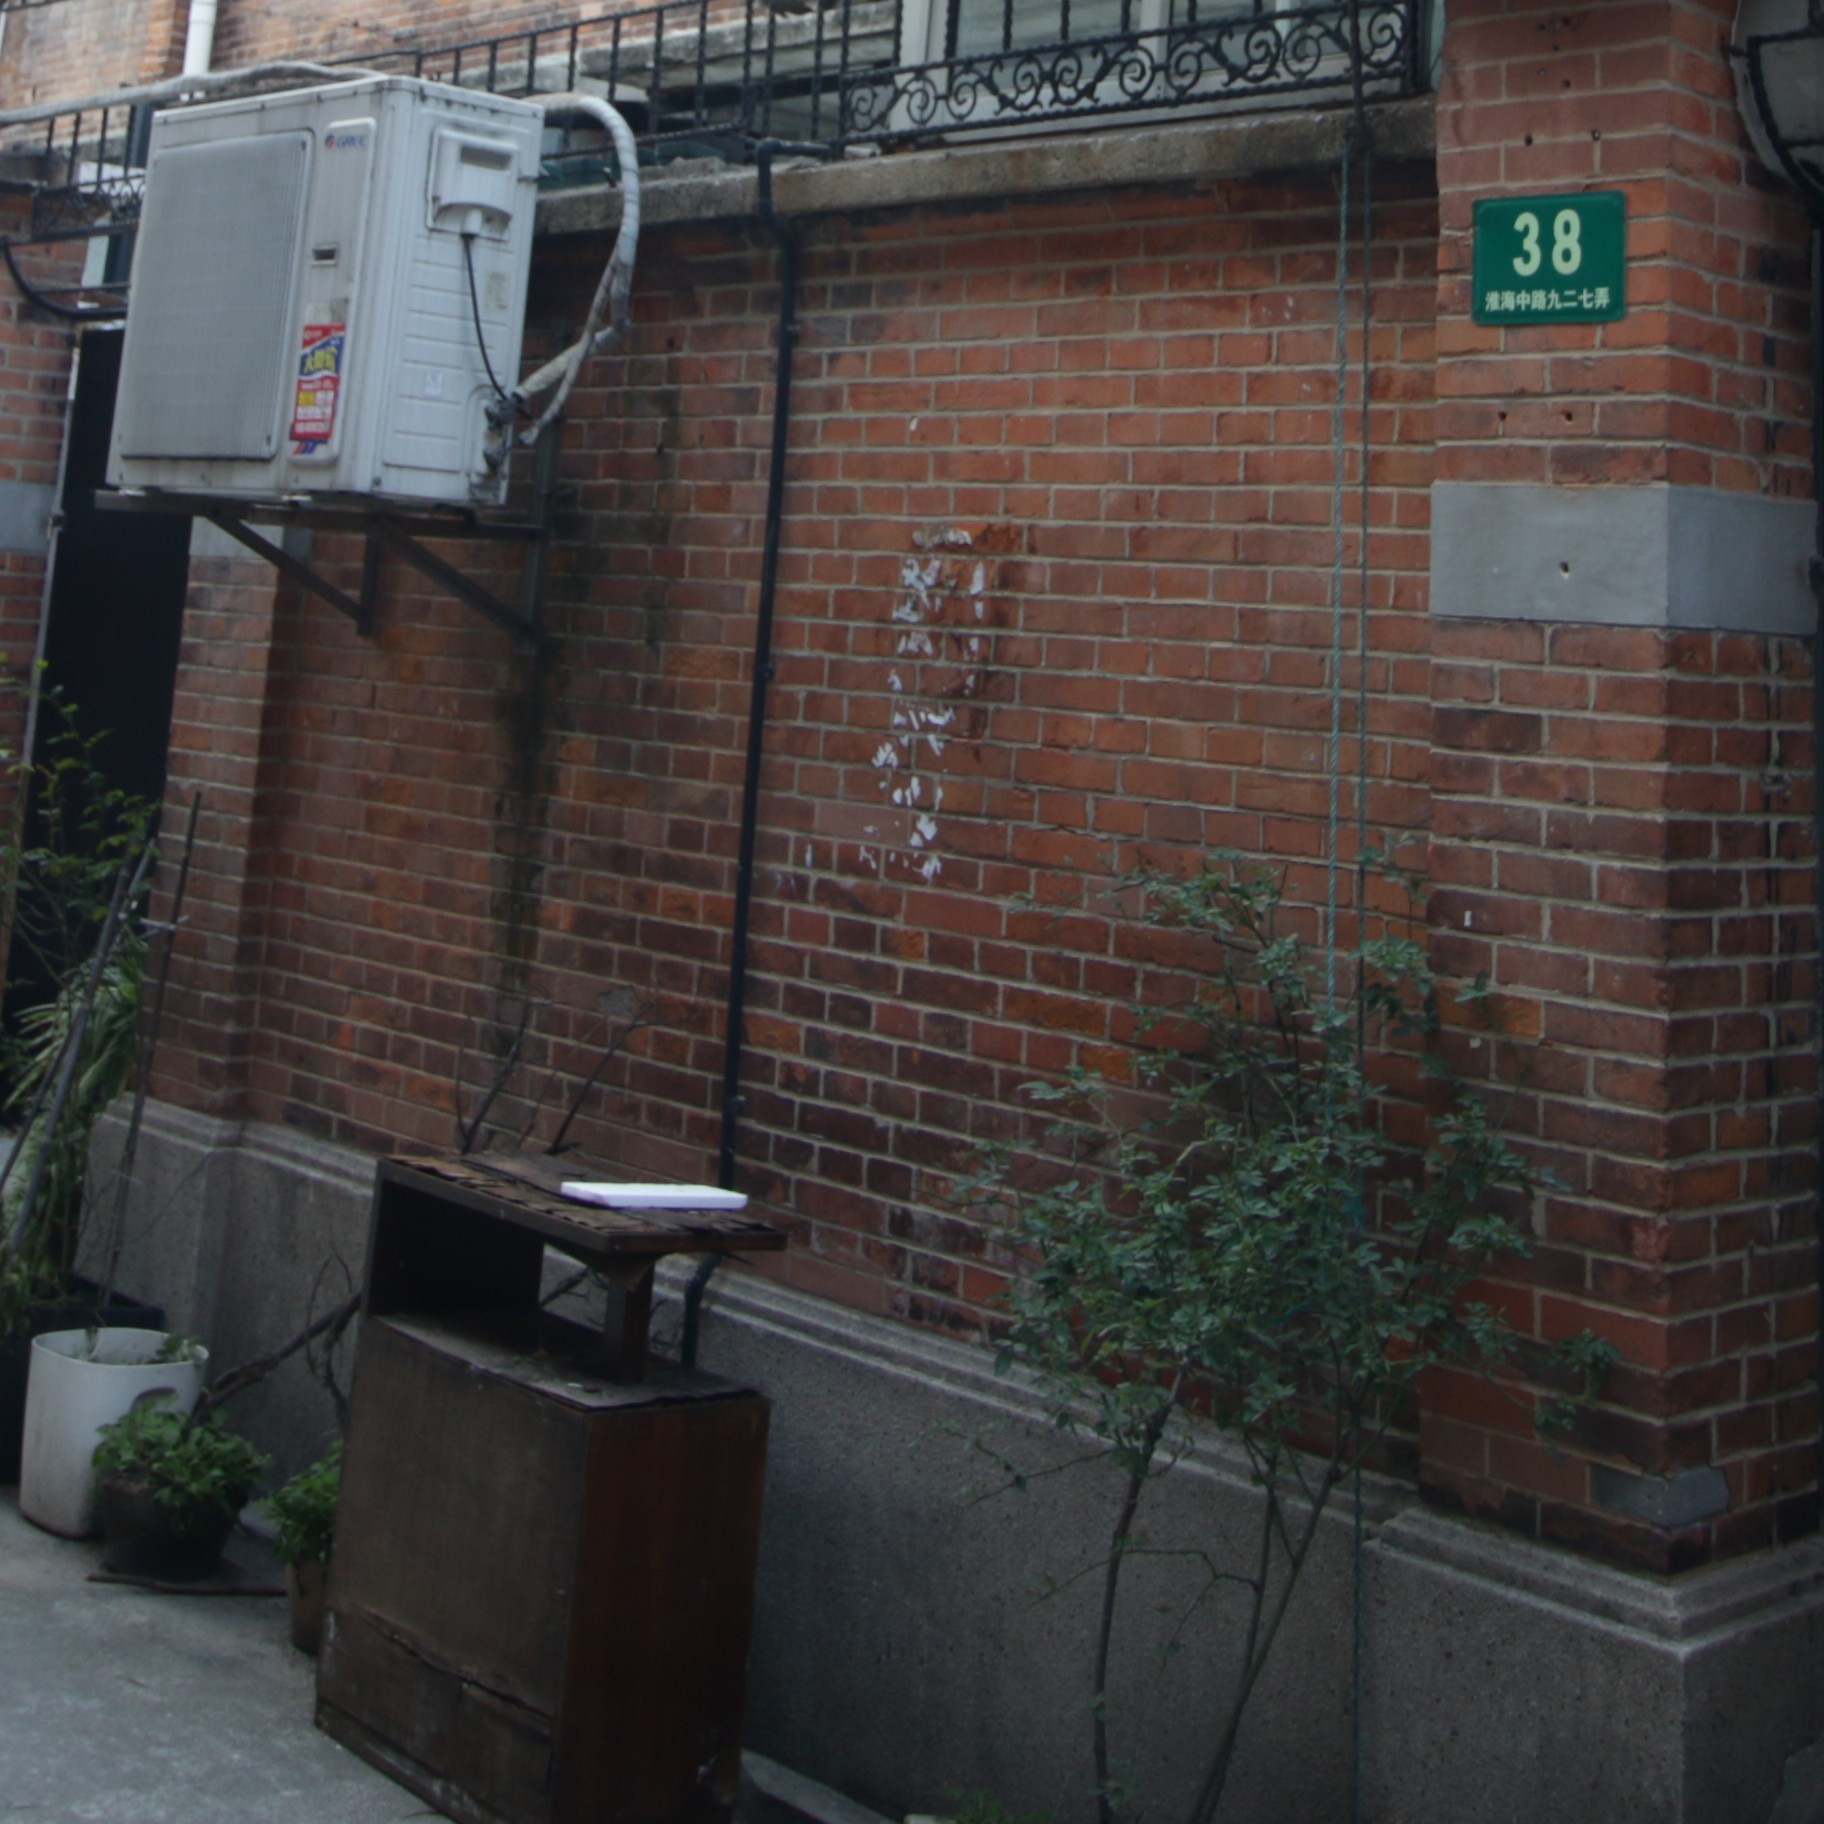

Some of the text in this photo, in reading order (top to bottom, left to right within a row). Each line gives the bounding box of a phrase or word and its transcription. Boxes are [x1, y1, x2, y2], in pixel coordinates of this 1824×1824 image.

[1513, 208, 1582, 277] 38
[1485, 287, 1610, 312] 淮海中路九二七弄
